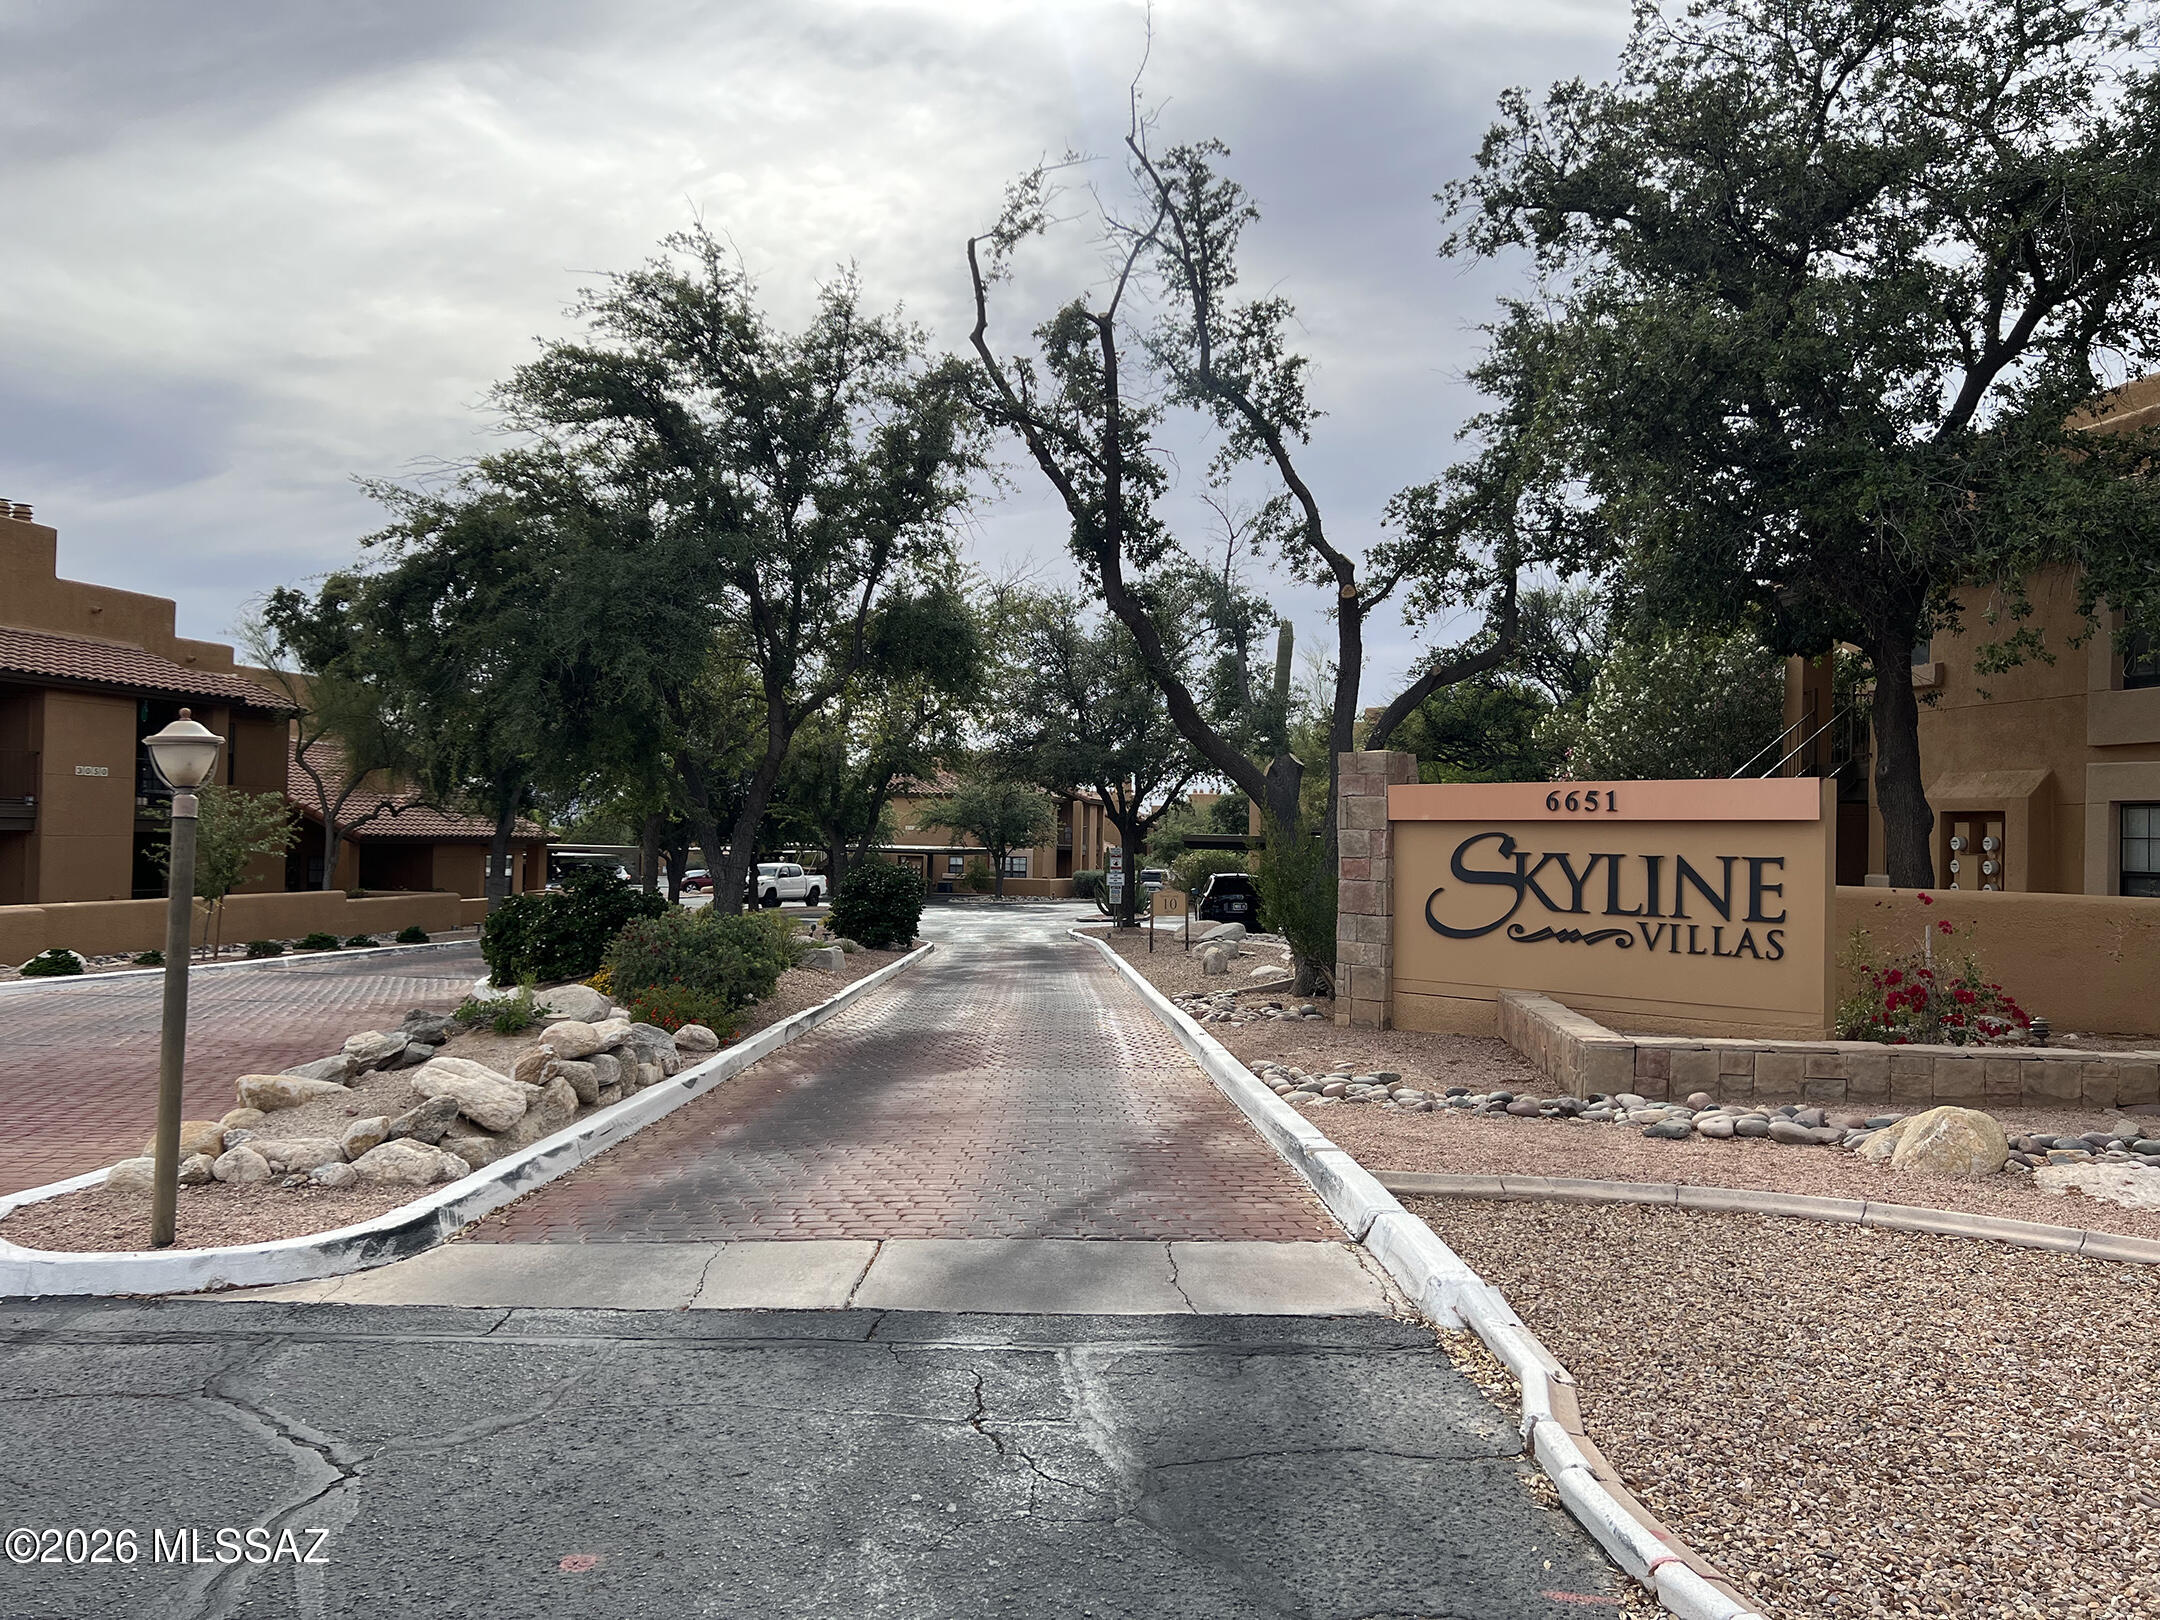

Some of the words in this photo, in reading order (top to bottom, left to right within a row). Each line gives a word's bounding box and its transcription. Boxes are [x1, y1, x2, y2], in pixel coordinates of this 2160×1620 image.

[1545, 789, 1619, 812] 6651
[1425, 832, 1787, 939] SKYLINE
[1163, 898, 1178, 910] 10
[1637, 921, 1785, 961] VILLAS
